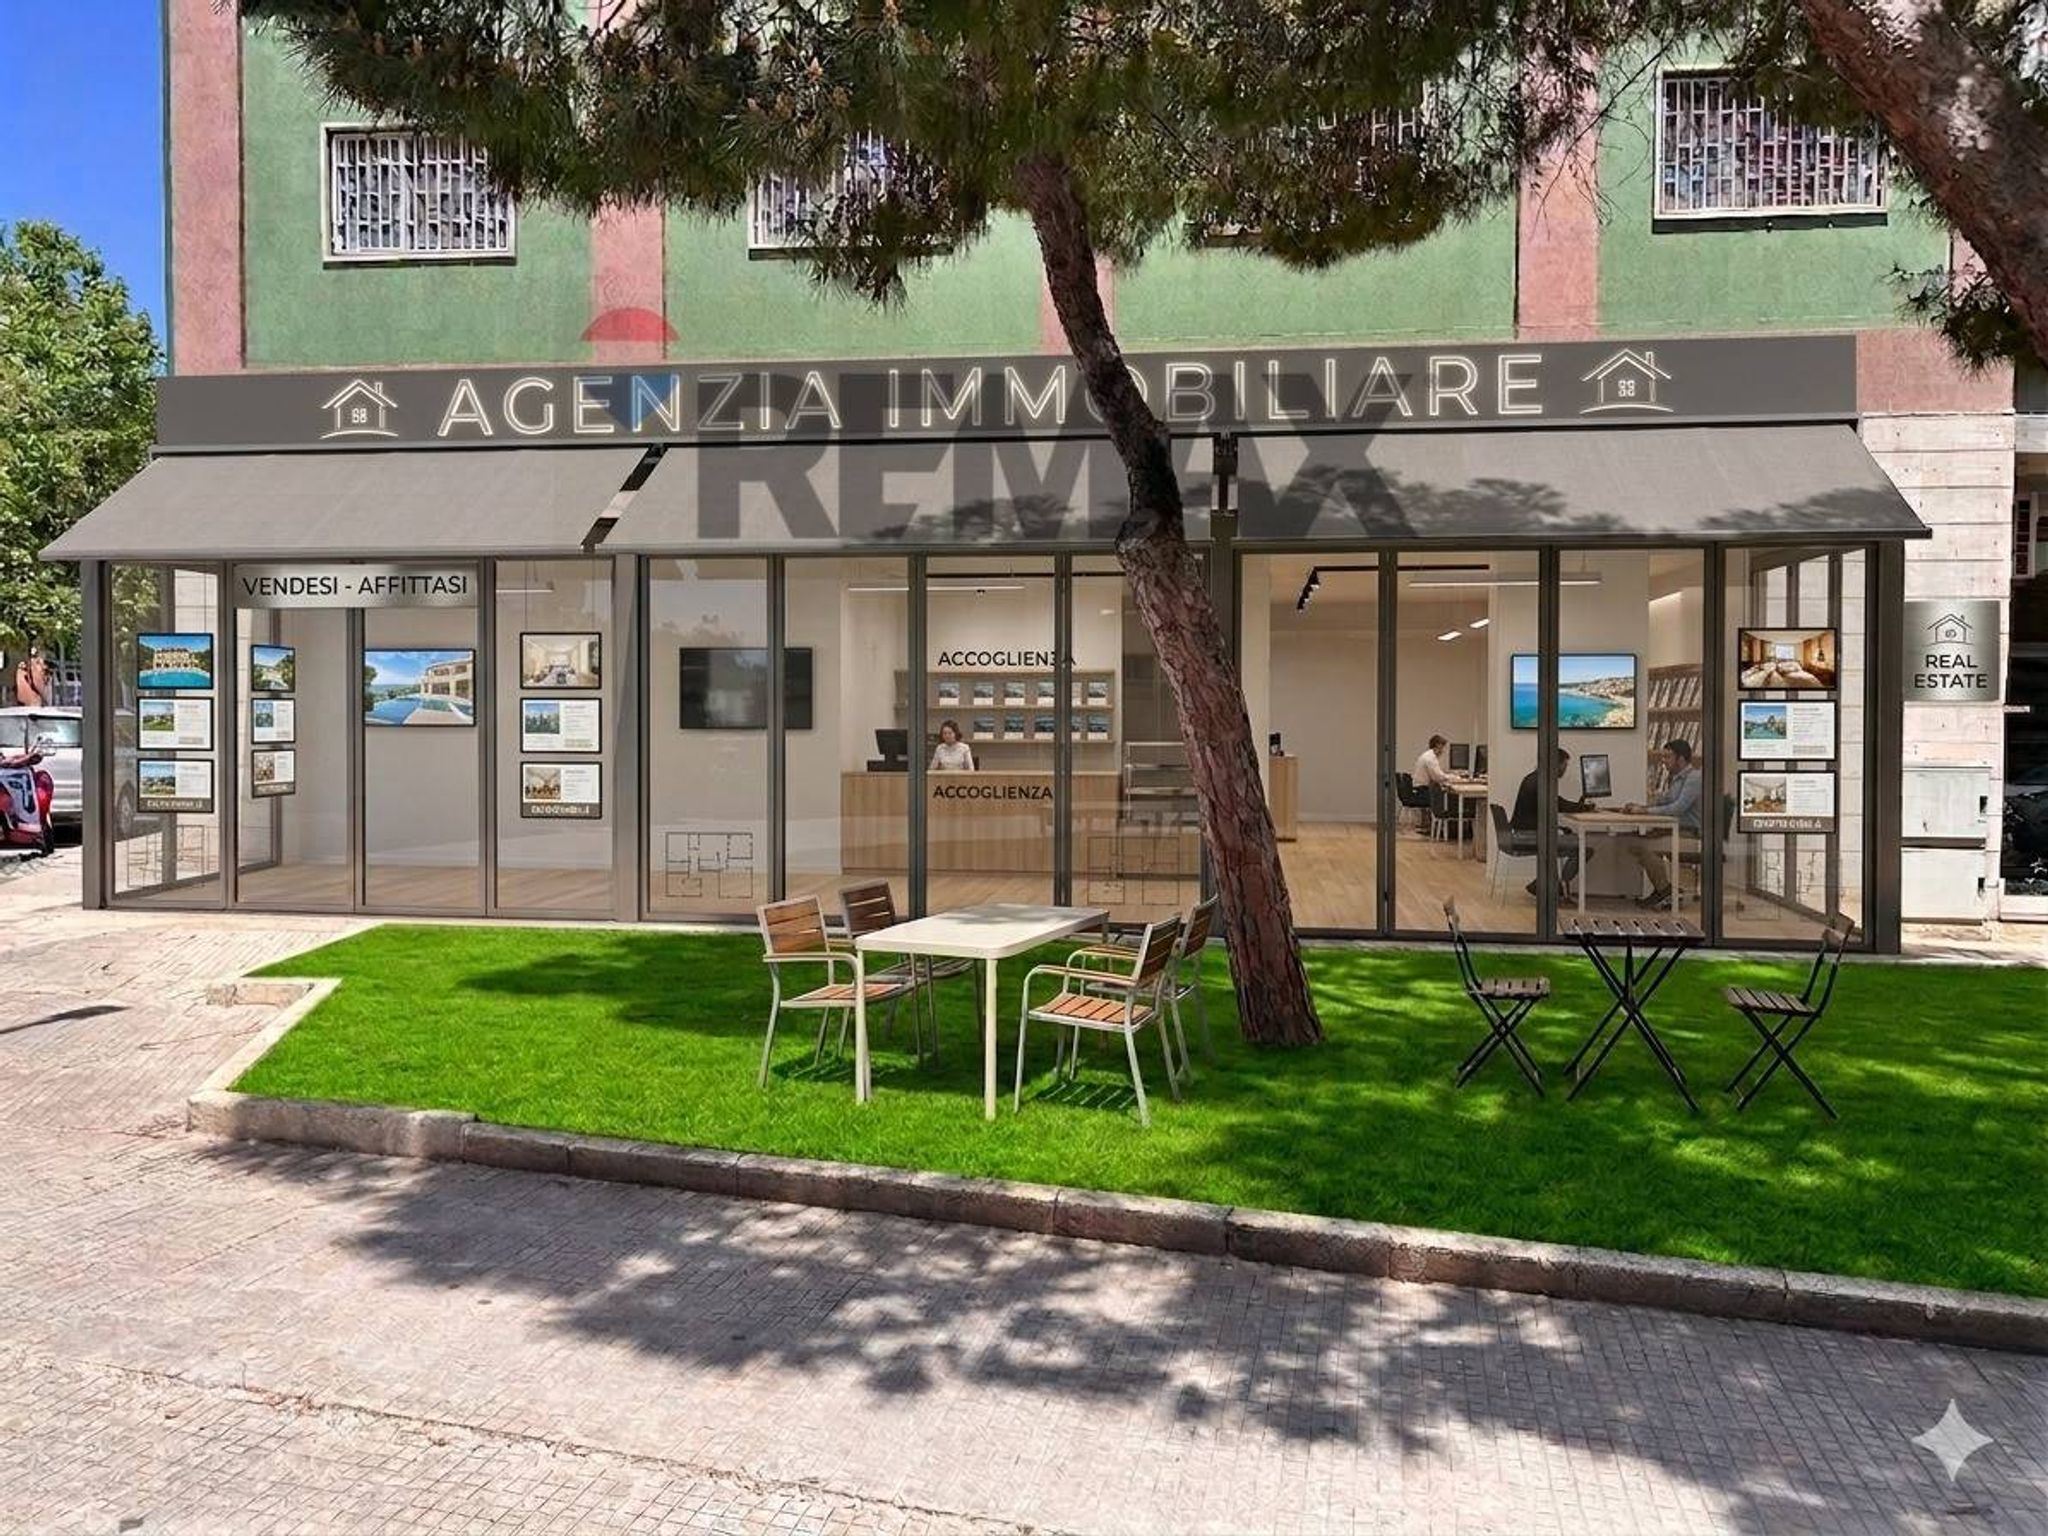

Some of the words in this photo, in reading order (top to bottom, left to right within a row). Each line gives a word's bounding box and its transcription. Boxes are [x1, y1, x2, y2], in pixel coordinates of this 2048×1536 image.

[436, 370, 842, 437] AGENZIA
[243, 577, 338, 596] VENDESI
[358, 575, 468, 595] AFFITTASI
[1925, 654, 1978, 668] REAL
[1914, 673, 1988, 689] ESTATE
[933, 785, 1053, 799] ACCOGLIENZA
